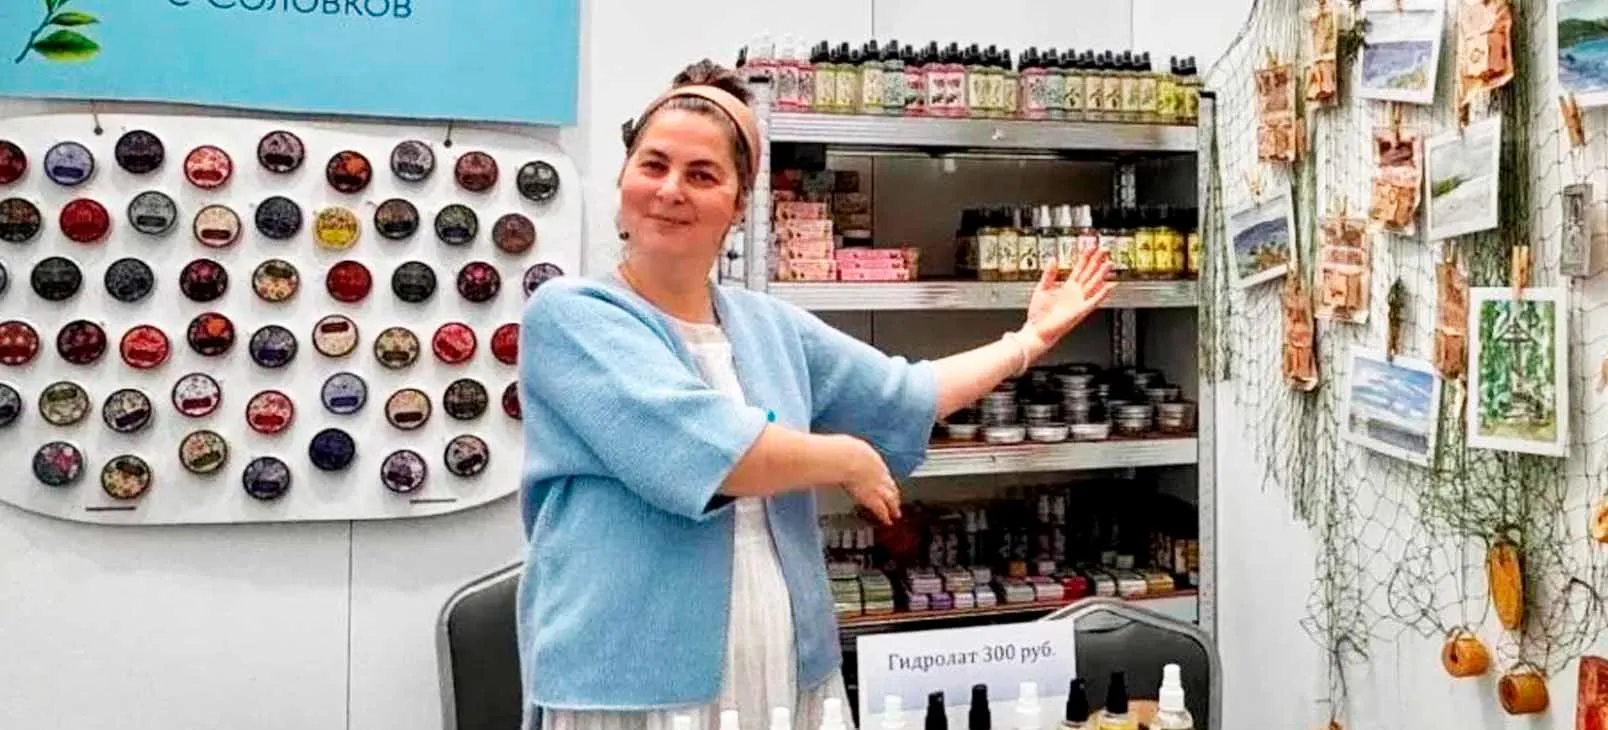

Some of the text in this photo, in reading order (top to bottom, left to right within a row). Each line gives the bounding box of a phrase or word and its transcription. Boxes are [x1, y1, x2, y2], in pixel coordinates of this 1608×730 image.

[207, 0, 412, 18] ловков
[888, 640, 1056, 672] Гидролат 300 руб.
